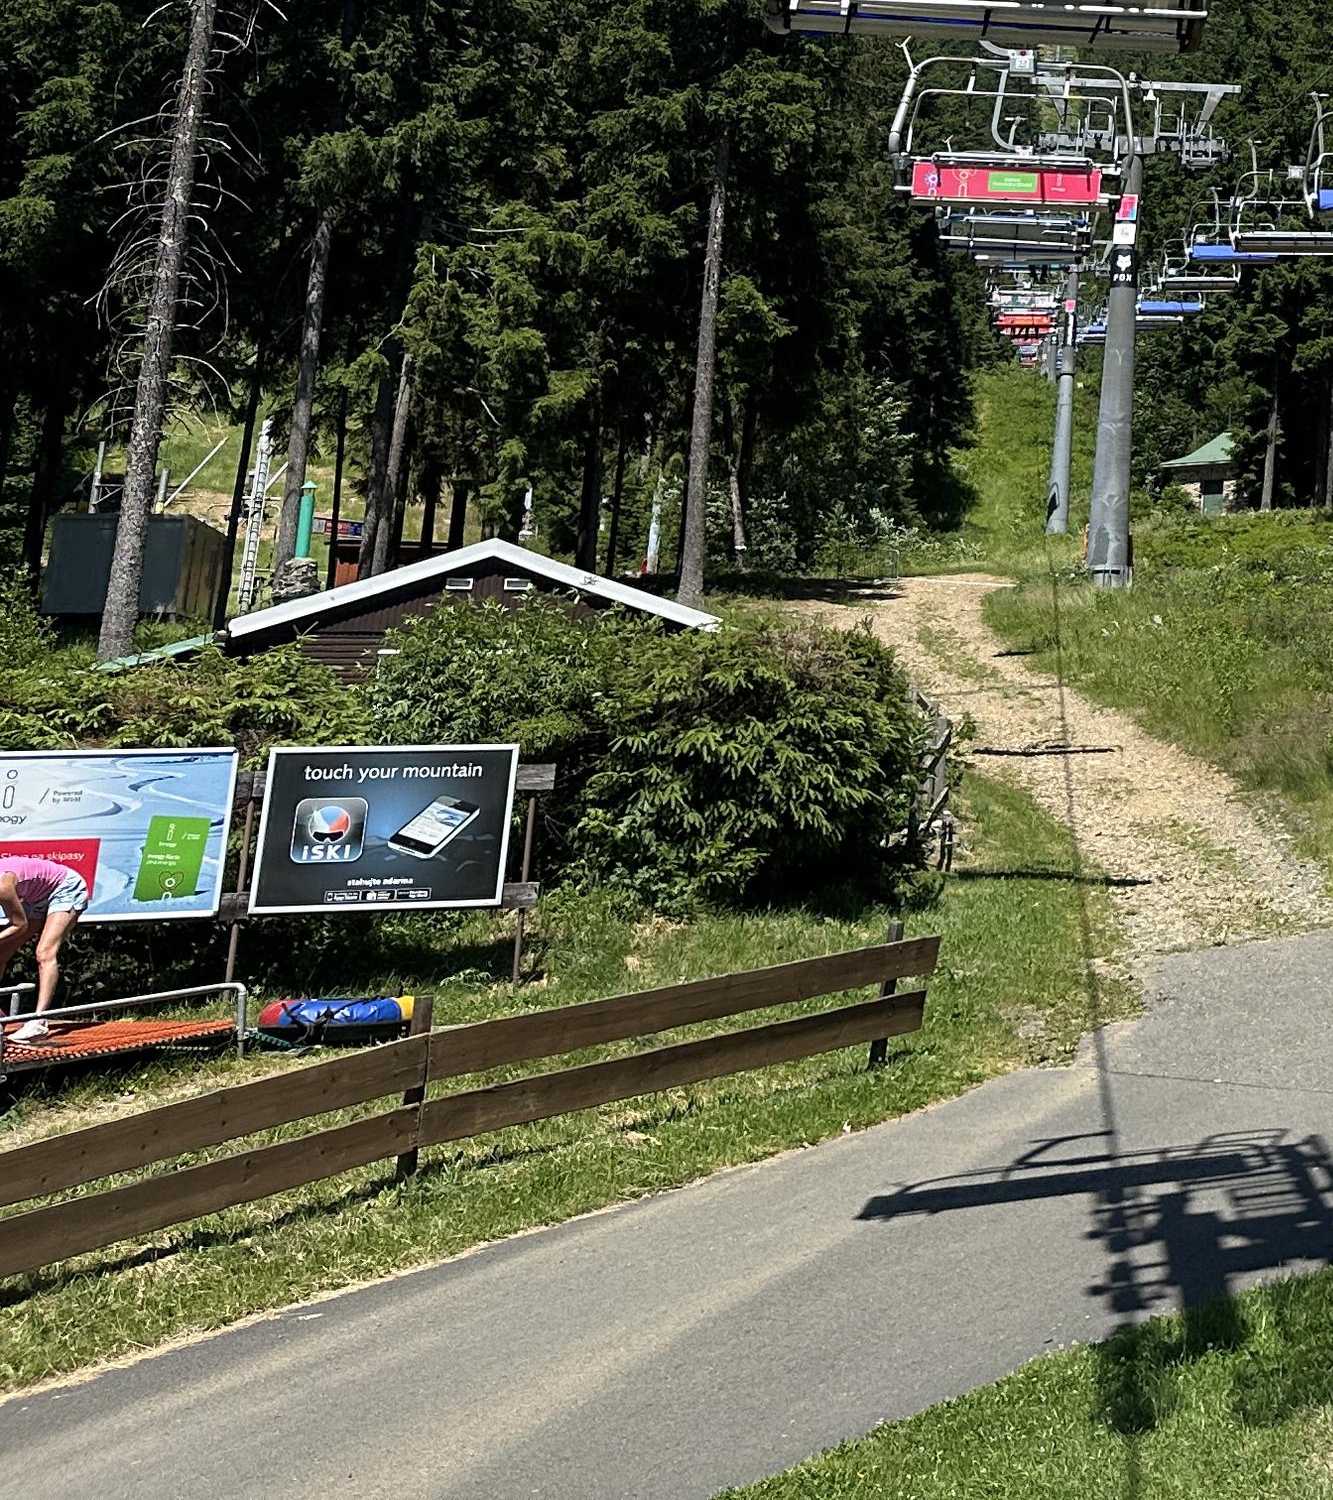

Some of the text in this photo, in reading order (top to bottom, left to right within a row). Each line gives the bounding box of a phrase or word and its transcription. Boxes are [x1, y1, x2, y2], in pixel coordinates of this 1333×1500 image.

[1113, 273, 1132, 282] FOX
[304, 762, 483, 783] touch your mountain
[0, 815, 27, 825] ogy
[47, 851, 85, 862] skipasy
[301, 844, 351, 861] iSKI
